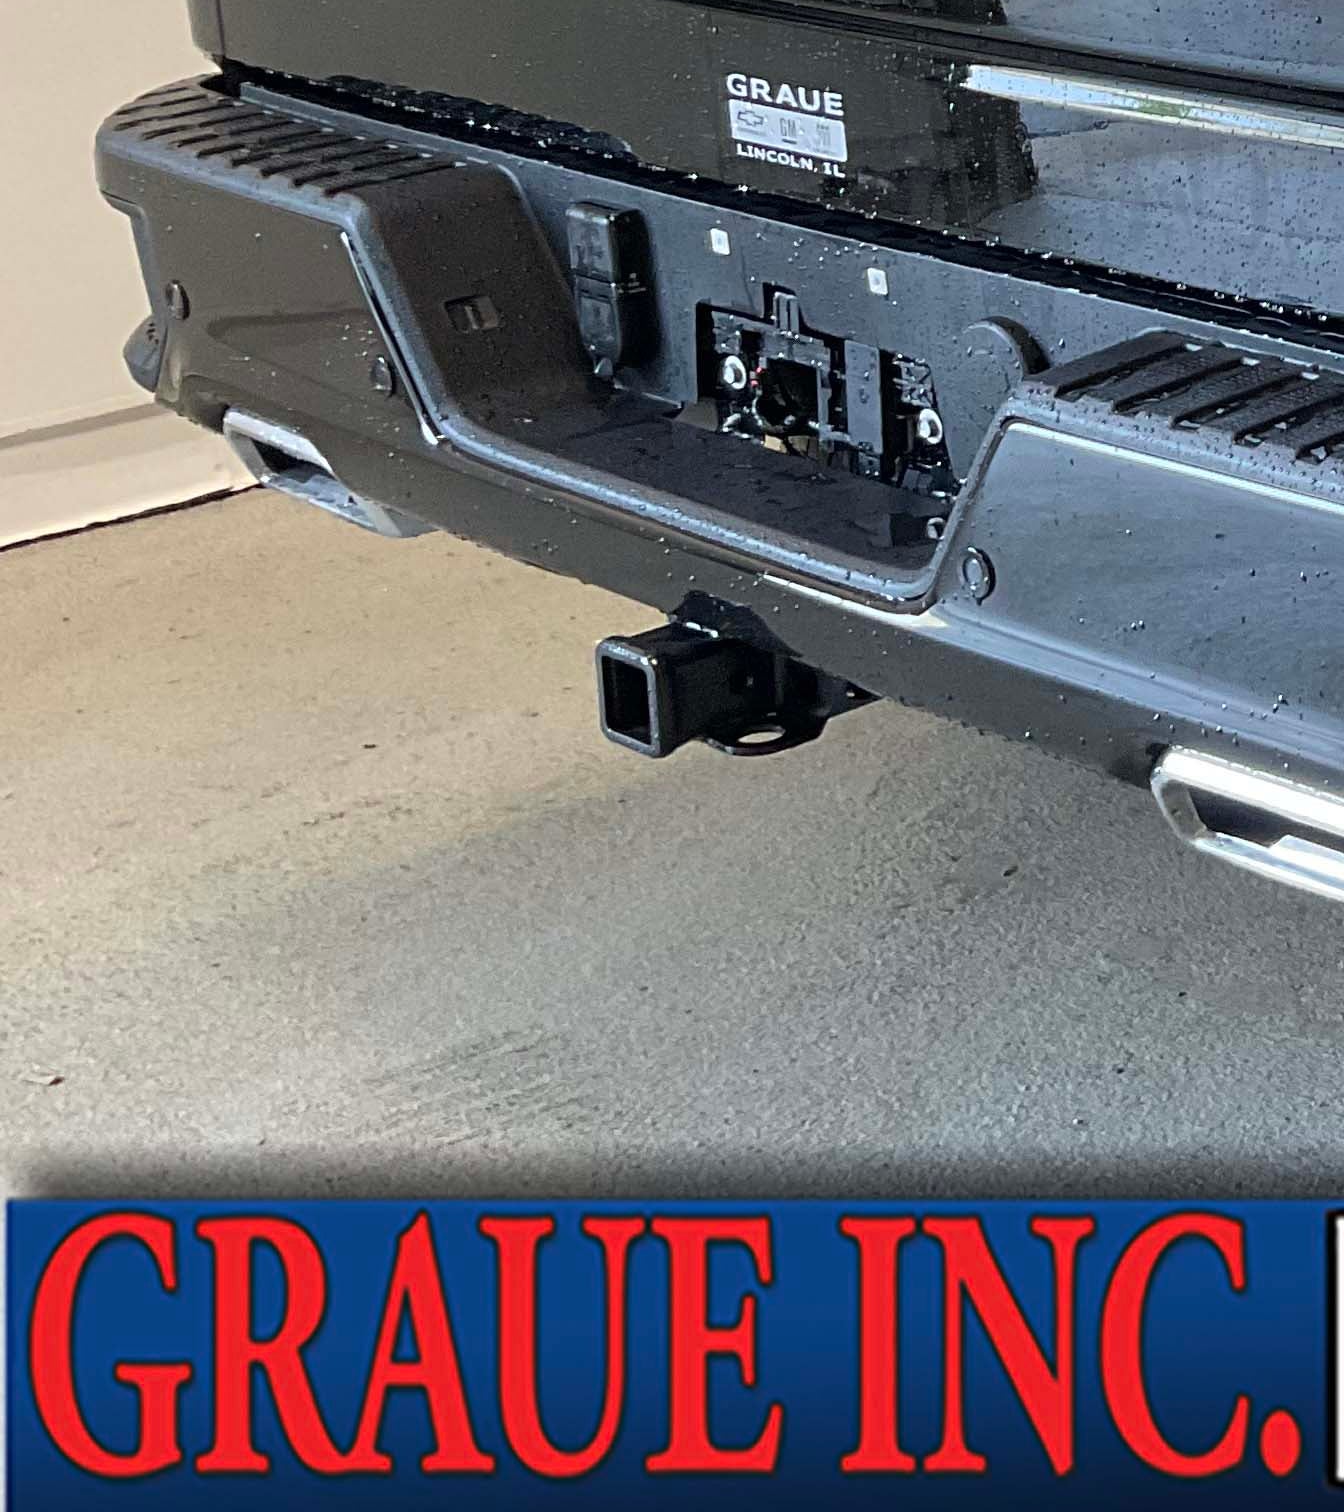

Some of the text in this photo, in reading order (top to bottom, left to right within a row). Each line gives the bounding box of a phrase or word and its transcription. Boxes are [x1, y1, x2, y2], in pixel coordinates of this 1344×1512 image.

[726, 72, 845, 117] GRAUE
[736, 143, 818, 174] LINCOLN,
[824, 161, 847, 179] IL
